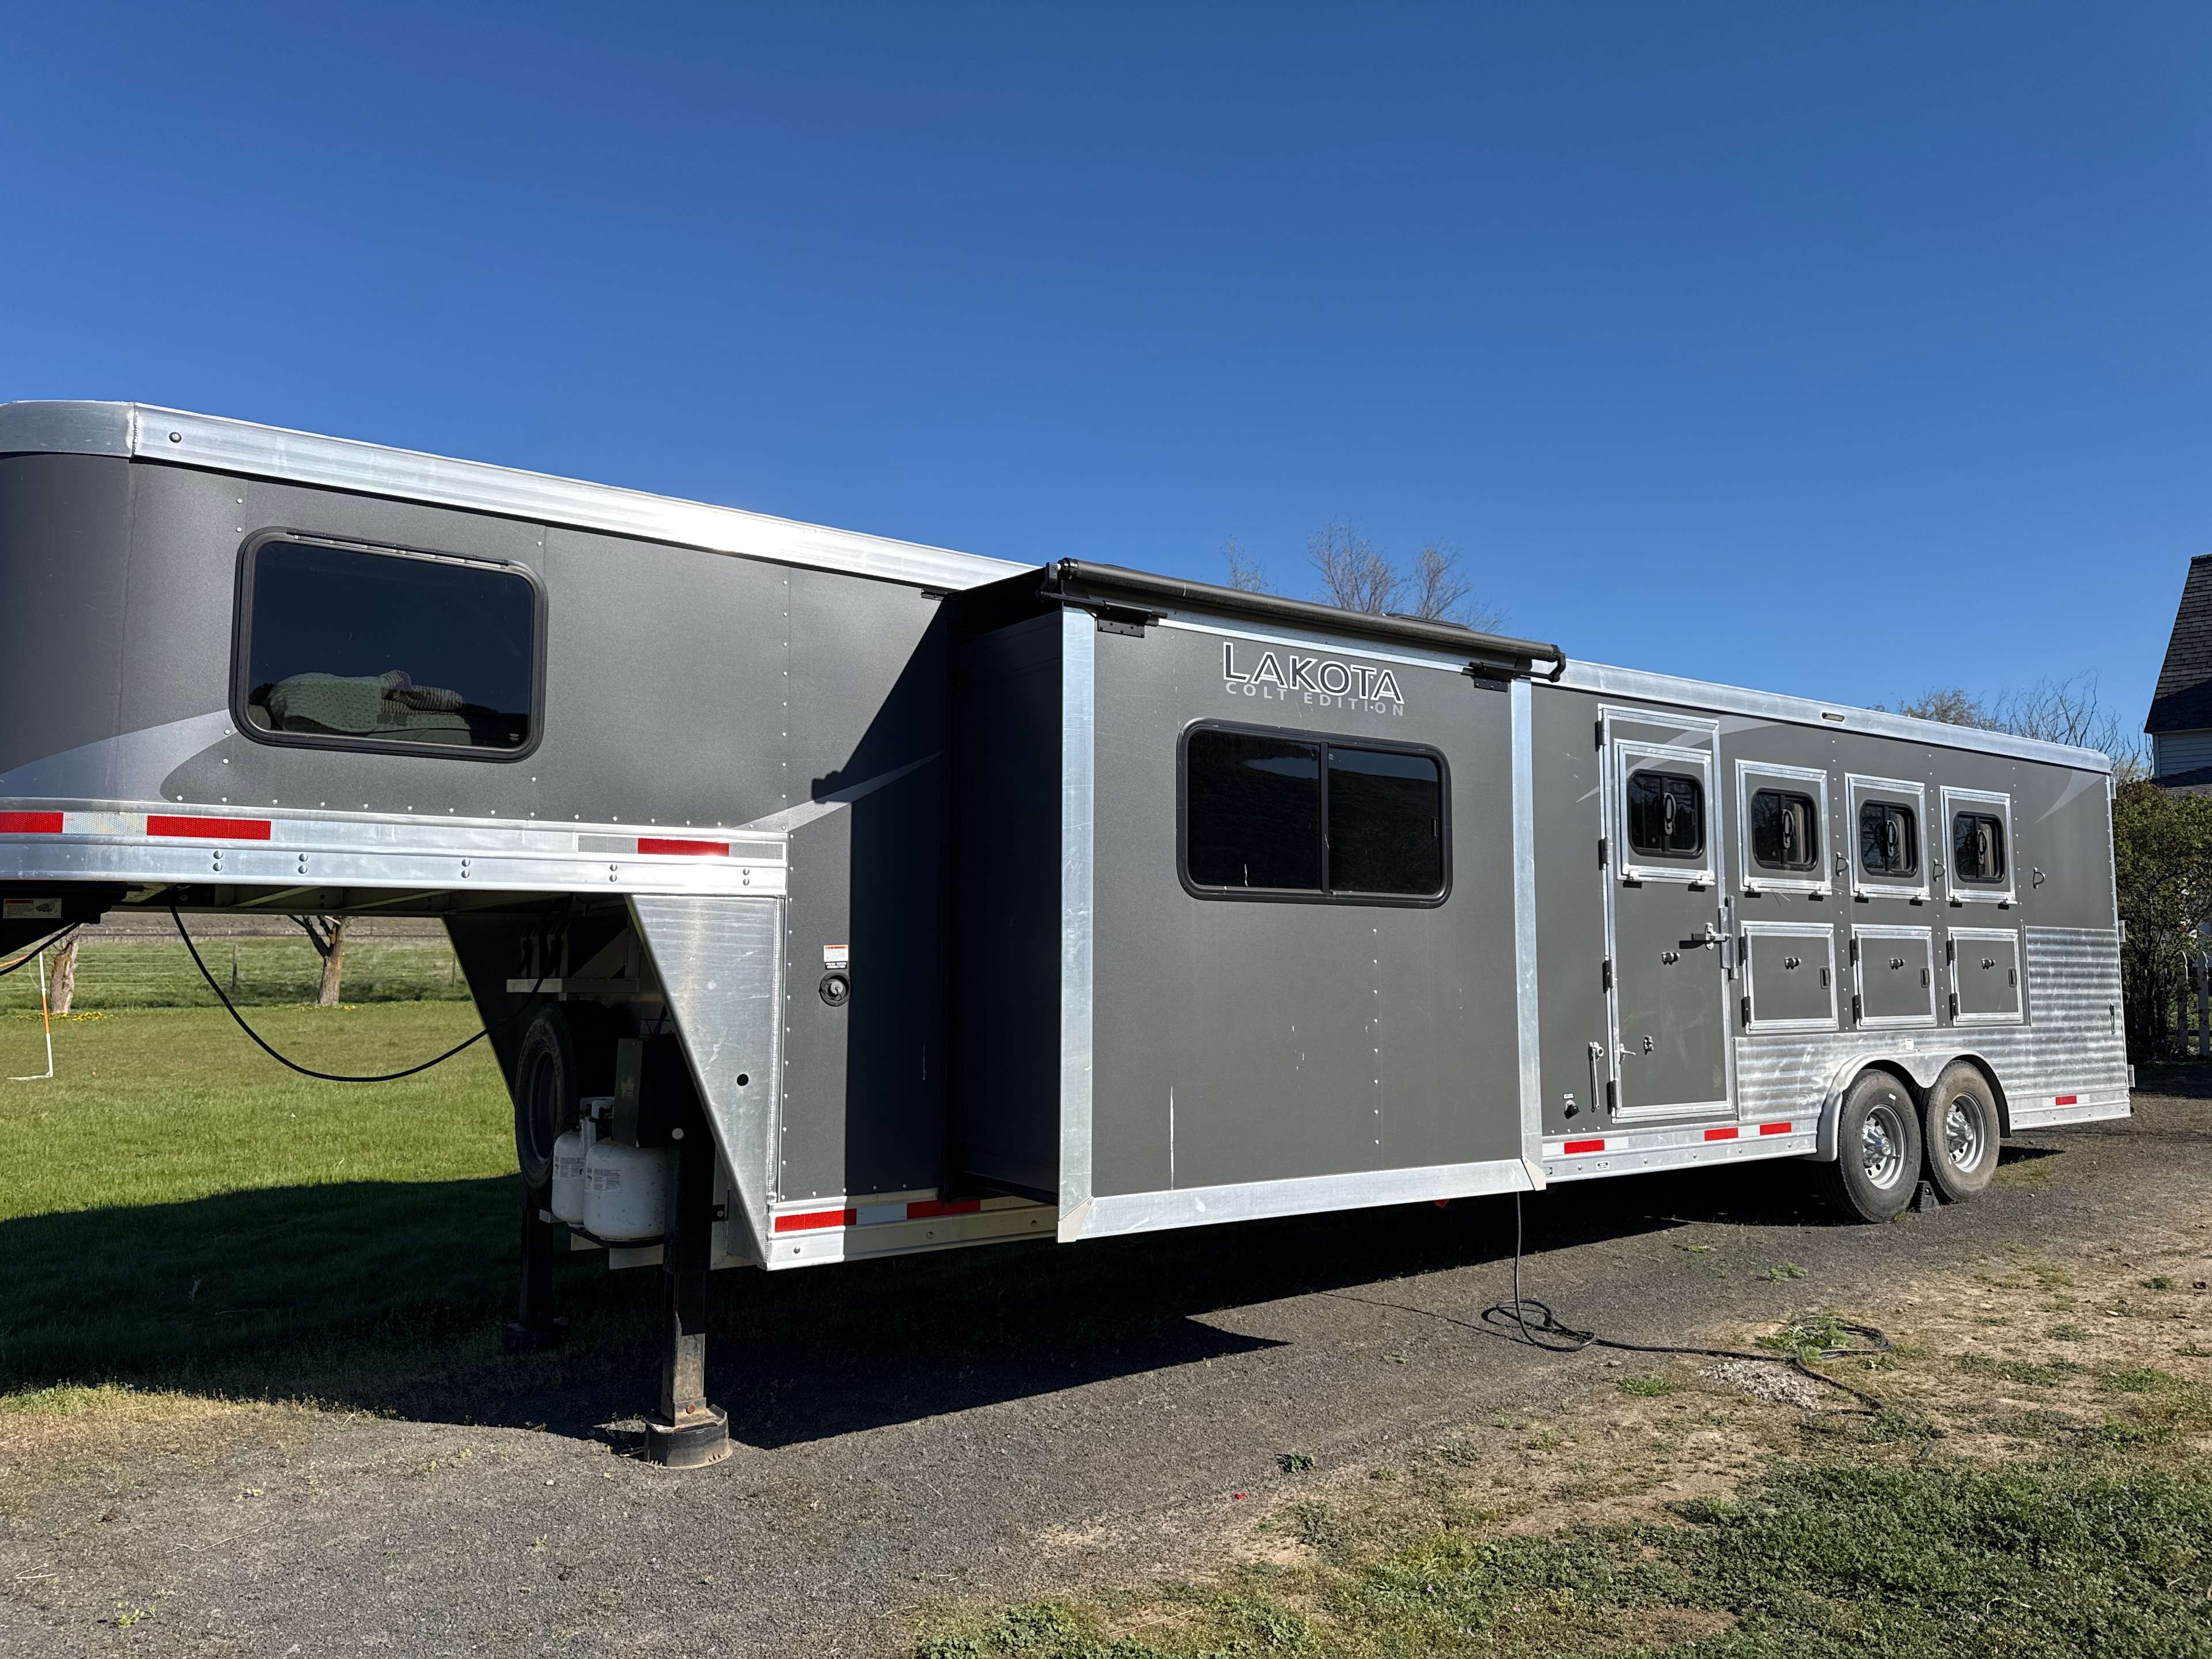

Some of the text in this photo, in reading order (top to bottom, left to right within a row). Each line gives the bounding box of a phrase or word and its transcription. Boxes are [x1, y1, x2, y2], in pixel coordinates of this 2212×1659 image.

[1224, 642, 1404, 704] LAKOTA
[1225, 682, 1403, 716] COLT EDITION
